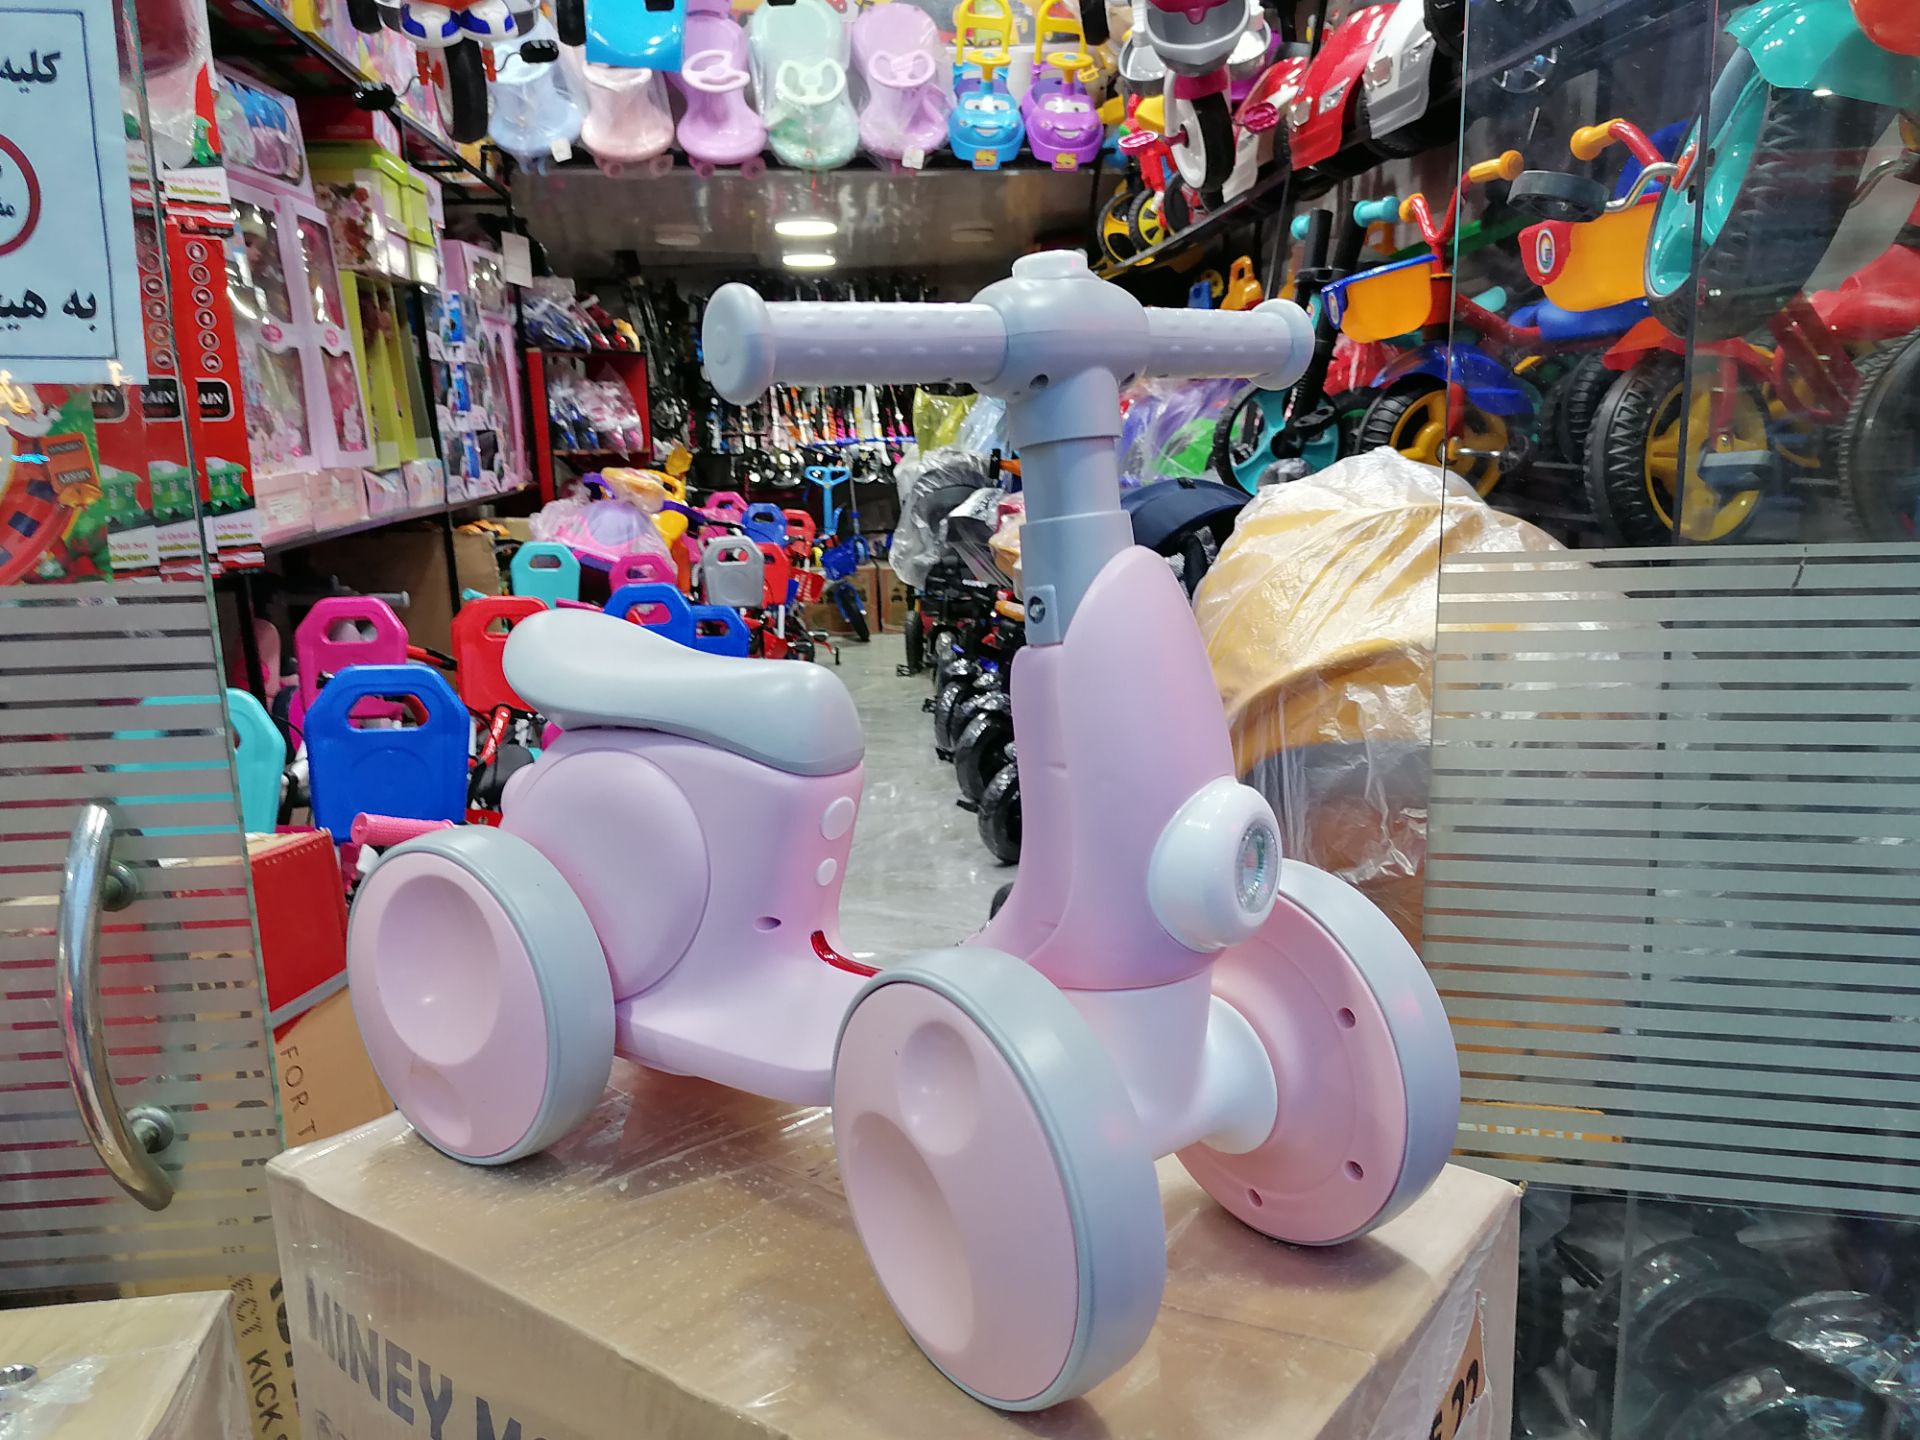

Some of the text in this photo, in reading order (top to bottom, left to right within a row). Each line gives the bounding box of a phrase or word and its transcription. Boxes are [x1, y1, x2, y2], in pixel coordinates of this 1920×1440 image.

[63, 289, 97, 332] به
[280, 1045, 309, 1113] FOR
[245, 1349, 284, 1433] KICK
